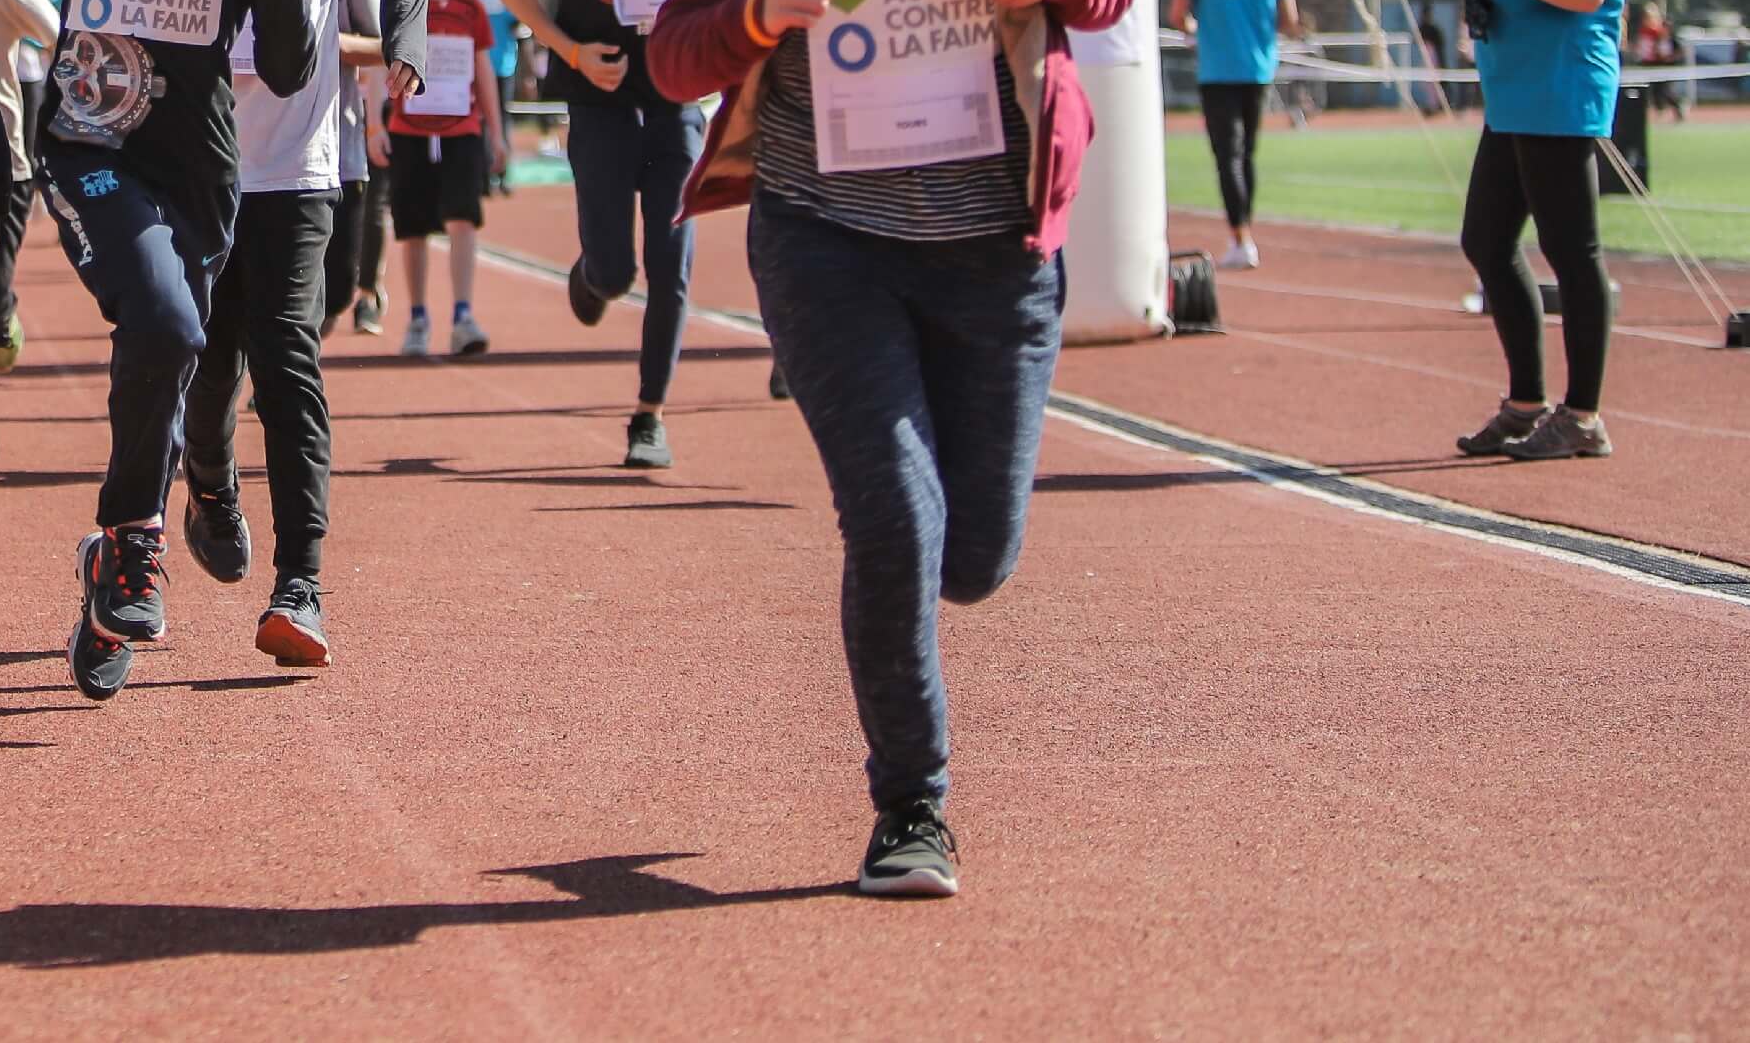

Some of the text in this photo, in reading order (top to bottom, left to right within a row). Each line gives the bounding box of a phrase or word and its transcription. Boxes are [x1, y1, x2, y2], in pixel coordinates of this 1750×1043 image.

[120, 4, 207, 34] LA FAIM
[889, 20, 1000, 60] LA FAIM
